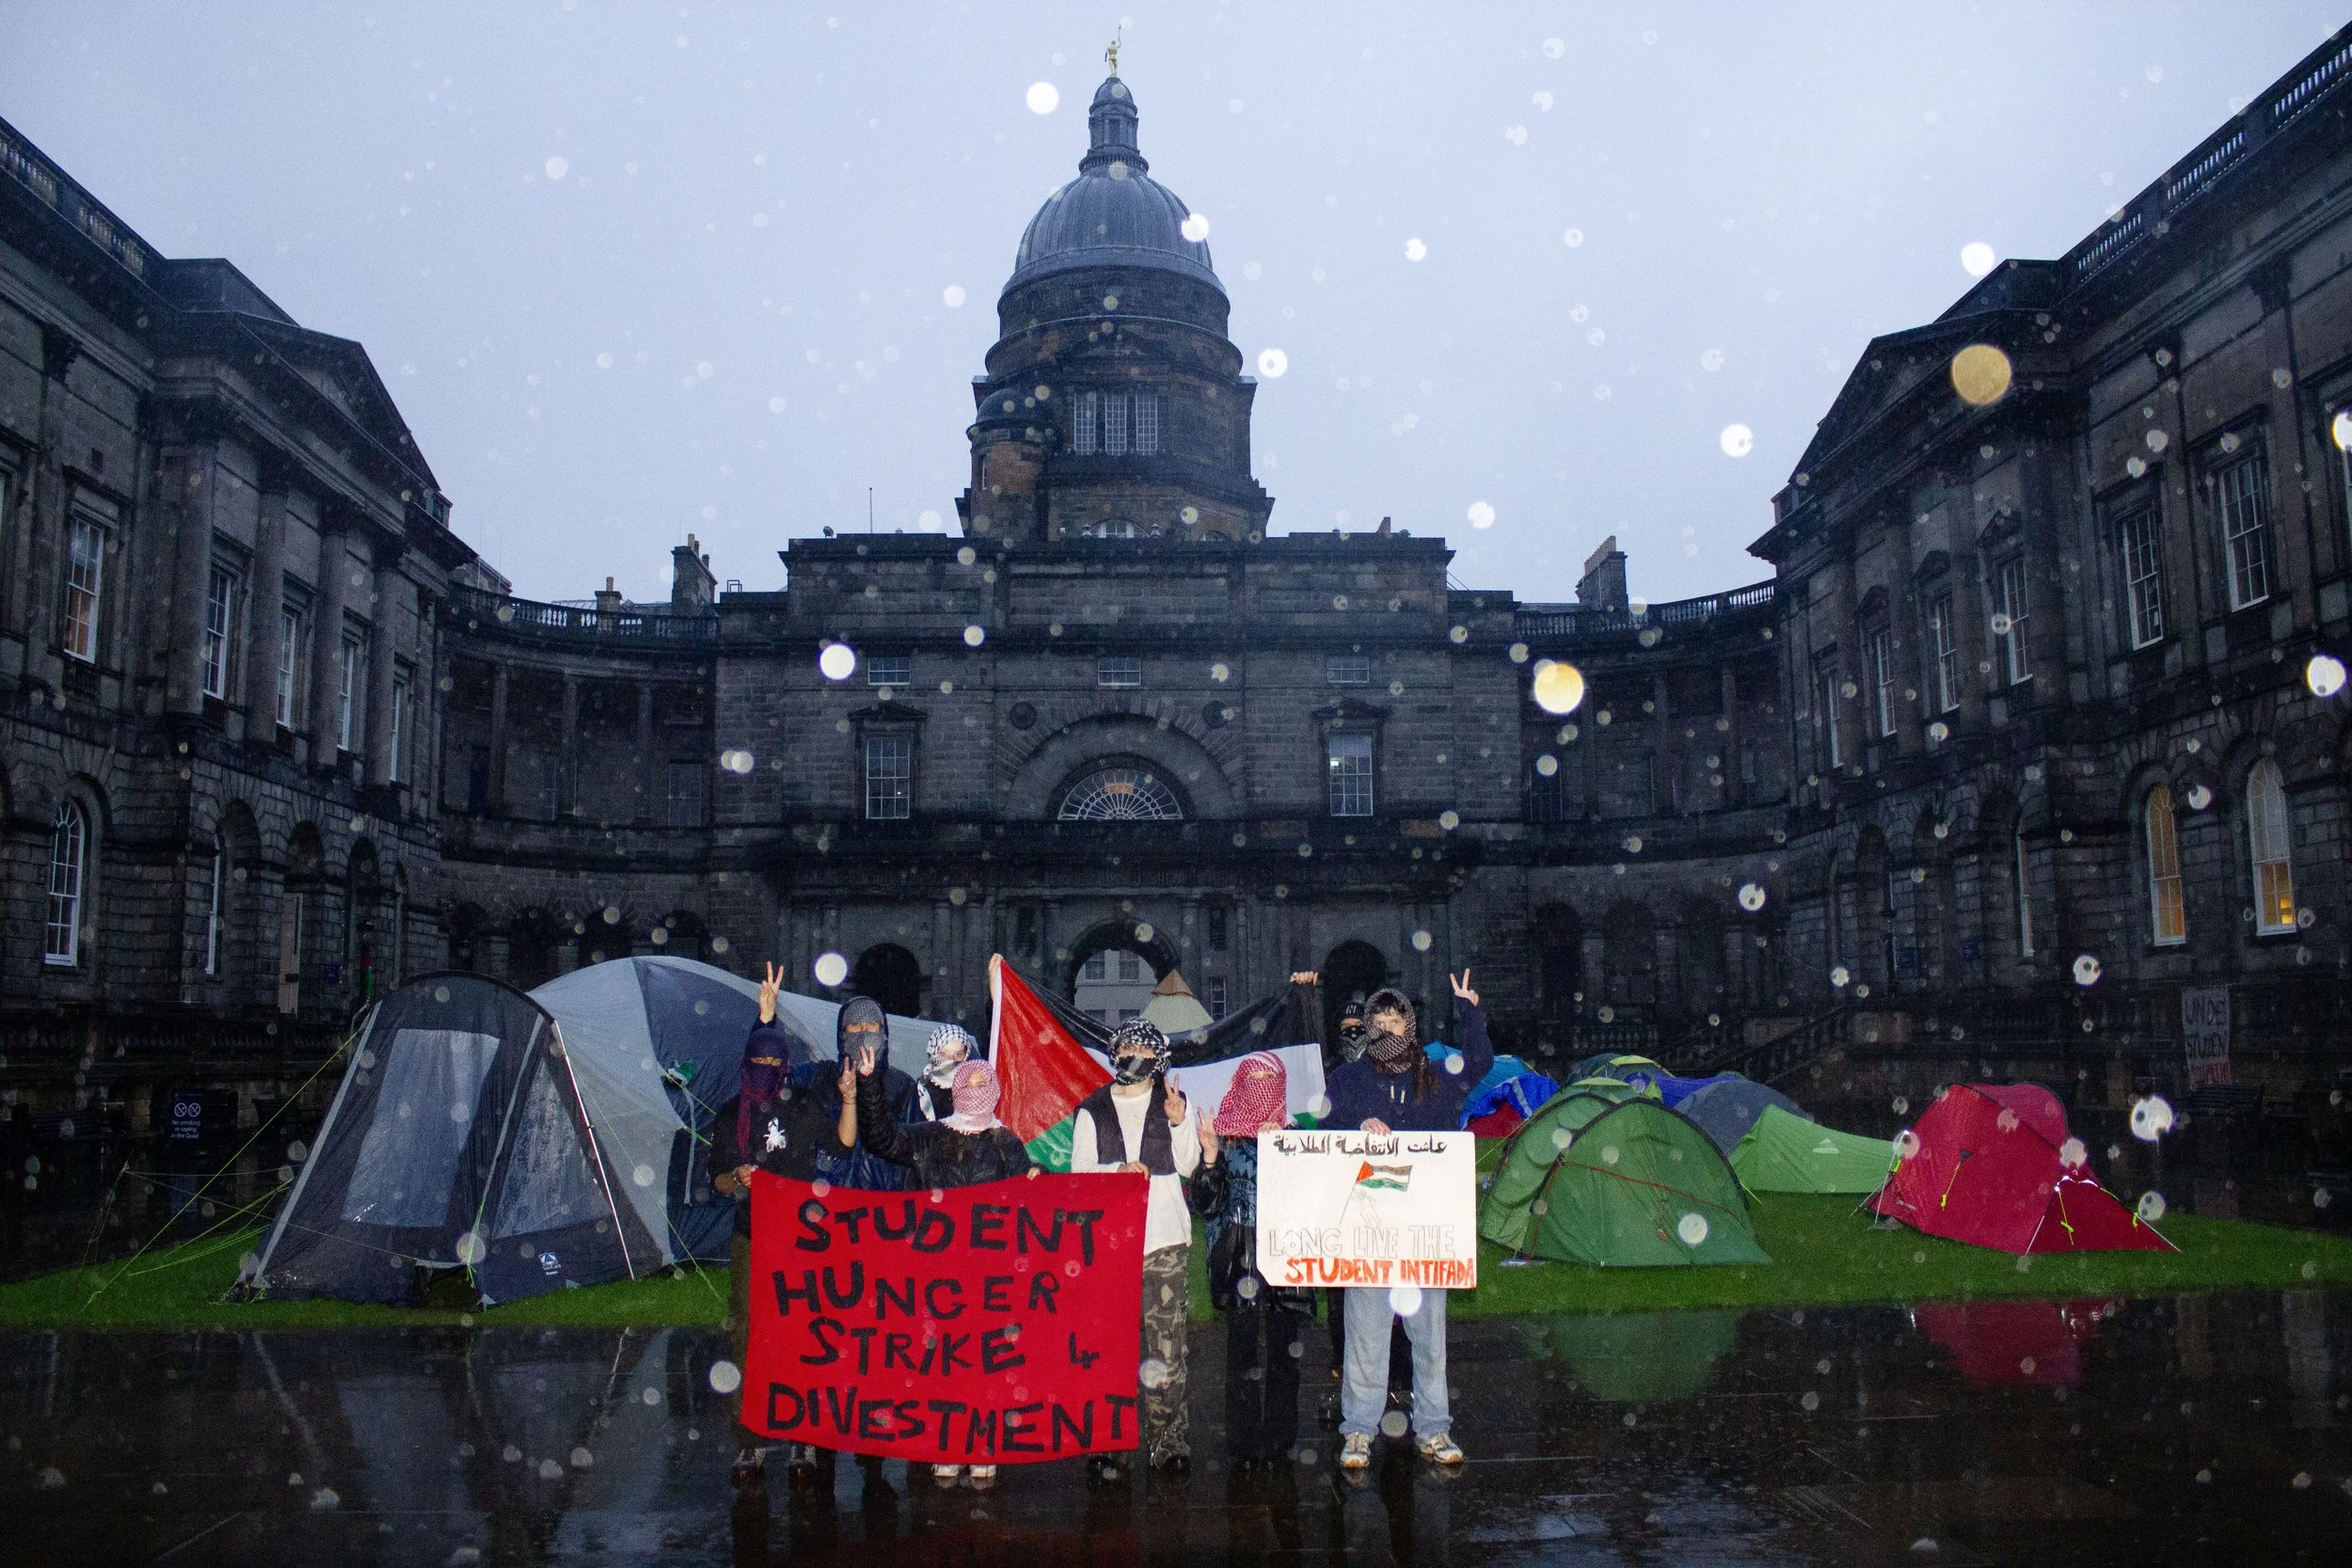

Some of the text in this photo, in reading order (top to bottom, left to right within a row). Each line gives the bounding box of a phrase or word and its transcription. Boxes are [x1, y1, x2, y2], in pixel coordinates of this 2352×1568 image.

[794, 1197, 1104, 1267] STUDENT
[1269, 1225, 1456, 1259] LONG LIVE THE
[771, 1259, 1060, 1321] HUNGER
[1285, 1256, 1476, 1287] STUDENT INTIFADA
[800, 1317, 1100, 1377] STRIKE 4
[766, 1381, 1137, 1456] DIVESTMENT
